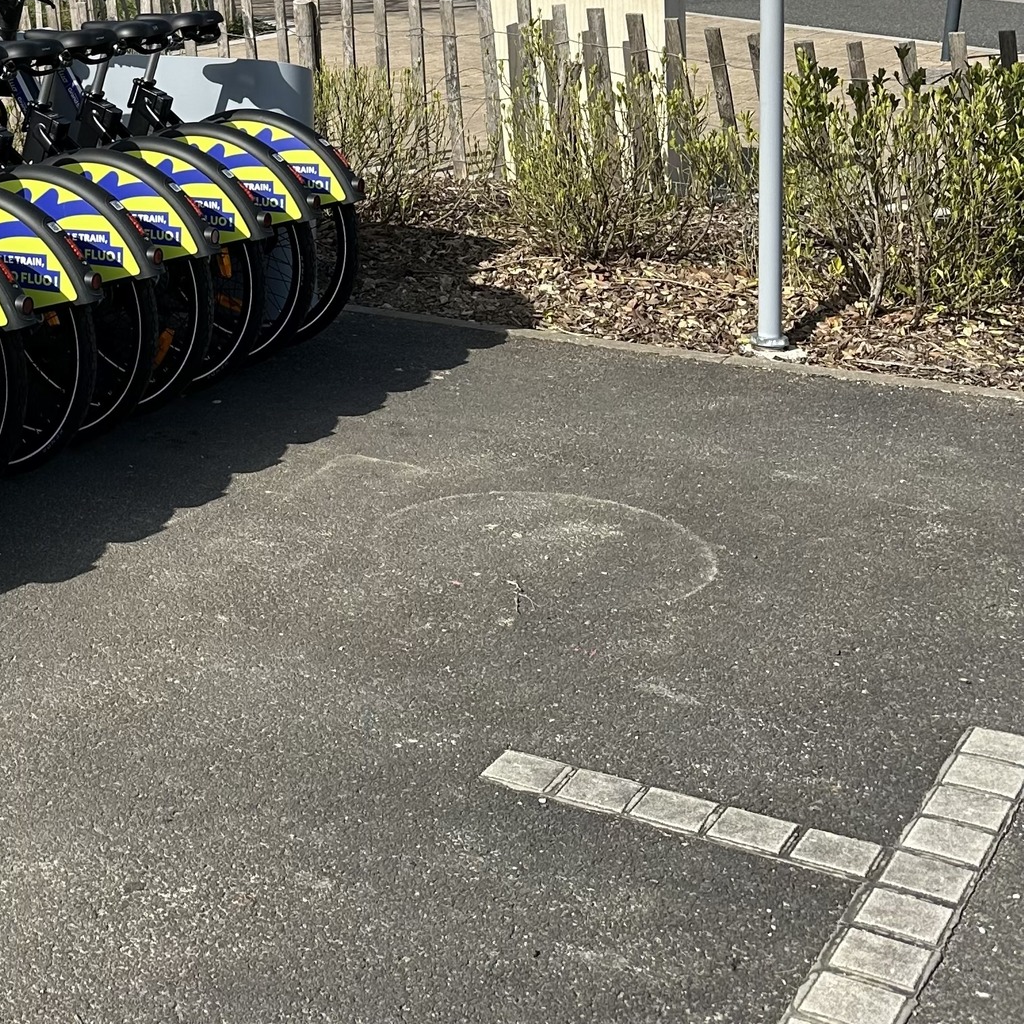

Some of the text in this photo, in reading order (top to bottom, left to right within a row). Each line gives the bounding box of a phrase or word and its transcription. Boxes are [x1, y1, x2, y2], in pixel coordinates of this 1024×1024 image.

[325, 180, 329, 191] !
[255, 197, 284, 208] LUO !
[137, 213, 166, 225] TRAIN,
[228, 217, 233, 227] !
[78, 232, 108, 244] TRAIN,
[175, 231, 180, 242] !
[3, 255, 45, 268] LE TRAIN,
[84, 249, 121, 263] FLUO !
[21, 271, 58, 287] FLUO !
